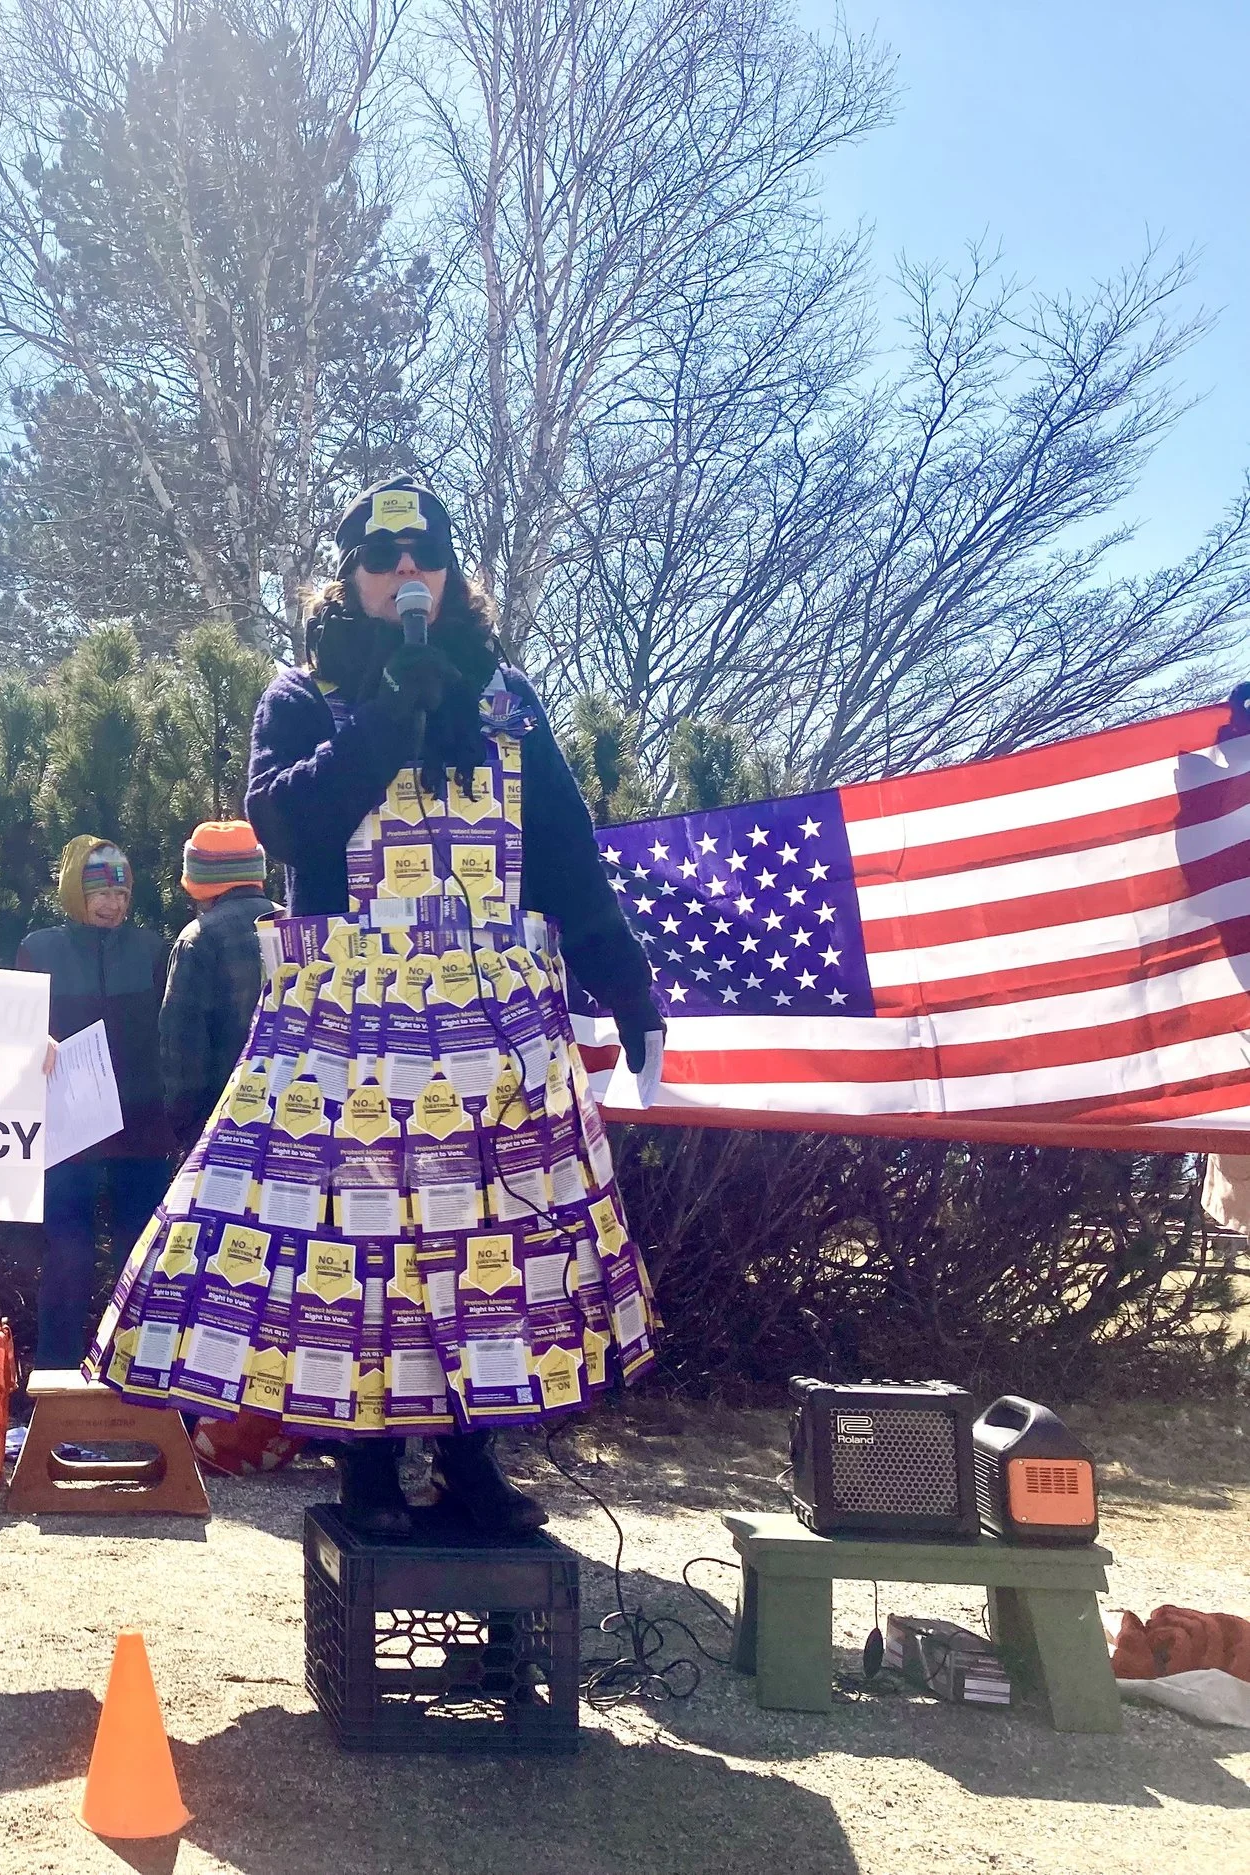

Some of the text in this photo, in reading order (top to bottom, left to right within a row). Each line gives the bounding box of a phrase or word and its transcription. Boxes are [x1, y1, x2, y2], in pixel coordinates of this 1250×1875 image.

[407, 501, 415, 509] 1
[397, 782, 412, 790] NO
[481, 781, 489, 793] 1
[421, 859, 429, 872] 1
[484, 860, 492, 872] 1
[346, 968, 360, 977] NO
[409, 967, 424, 975] NO
[442, 965, 458, 973] NO
[467, 963, 475, 974] 1
[322, 1019, 339, 1029] Right
[394, 1021, 412, 1029] Right
[442, 1019, 459, 1027] Right
[240, 1084, 253, 1092] NO
[497, 1085, 511, 1093] NO
[259, 1088, 266, 1100] 1
[288, 1094, 303, 1102] NO
[311, 1097, 320, 1110] 1
[450, 1094, 459, 1107] 1
[378, 1100, 386, 1112] 1
[272, 1147, 291, 1156] Right
[299, 1150, 317, 1159] Vote.
[186, 1237, 193, 1250] 1
[231, 1239, 246, 1249] NO
[253, 1246, 262, 1260] 1
[478, 1250, 492, 1258] NO
[501, 1249, 509, 1262] 1
[318, 1256, 334, 1265] NO
[342, 1259, 351, 1273] 1
[208, 1292, 226, 1302] Right
[234, 1299, 252, 1309] Vote.
[300, 1305, 326, 1313] Protect
[470, 1306, 488, 1315] Right
[305, 1312, 323, 1322] Right
[331, 1315, 349, 1324] Vote.
[397, 1316, 414, 1324] Right
[248, 1376, 256, 1389] 1
[543, 1380, 551, 1393] 1
[557, 1381, 571, 1391] NO
[264, 1386, 280, 1396] NO
[837, 1435, 874, 1444] Roland
